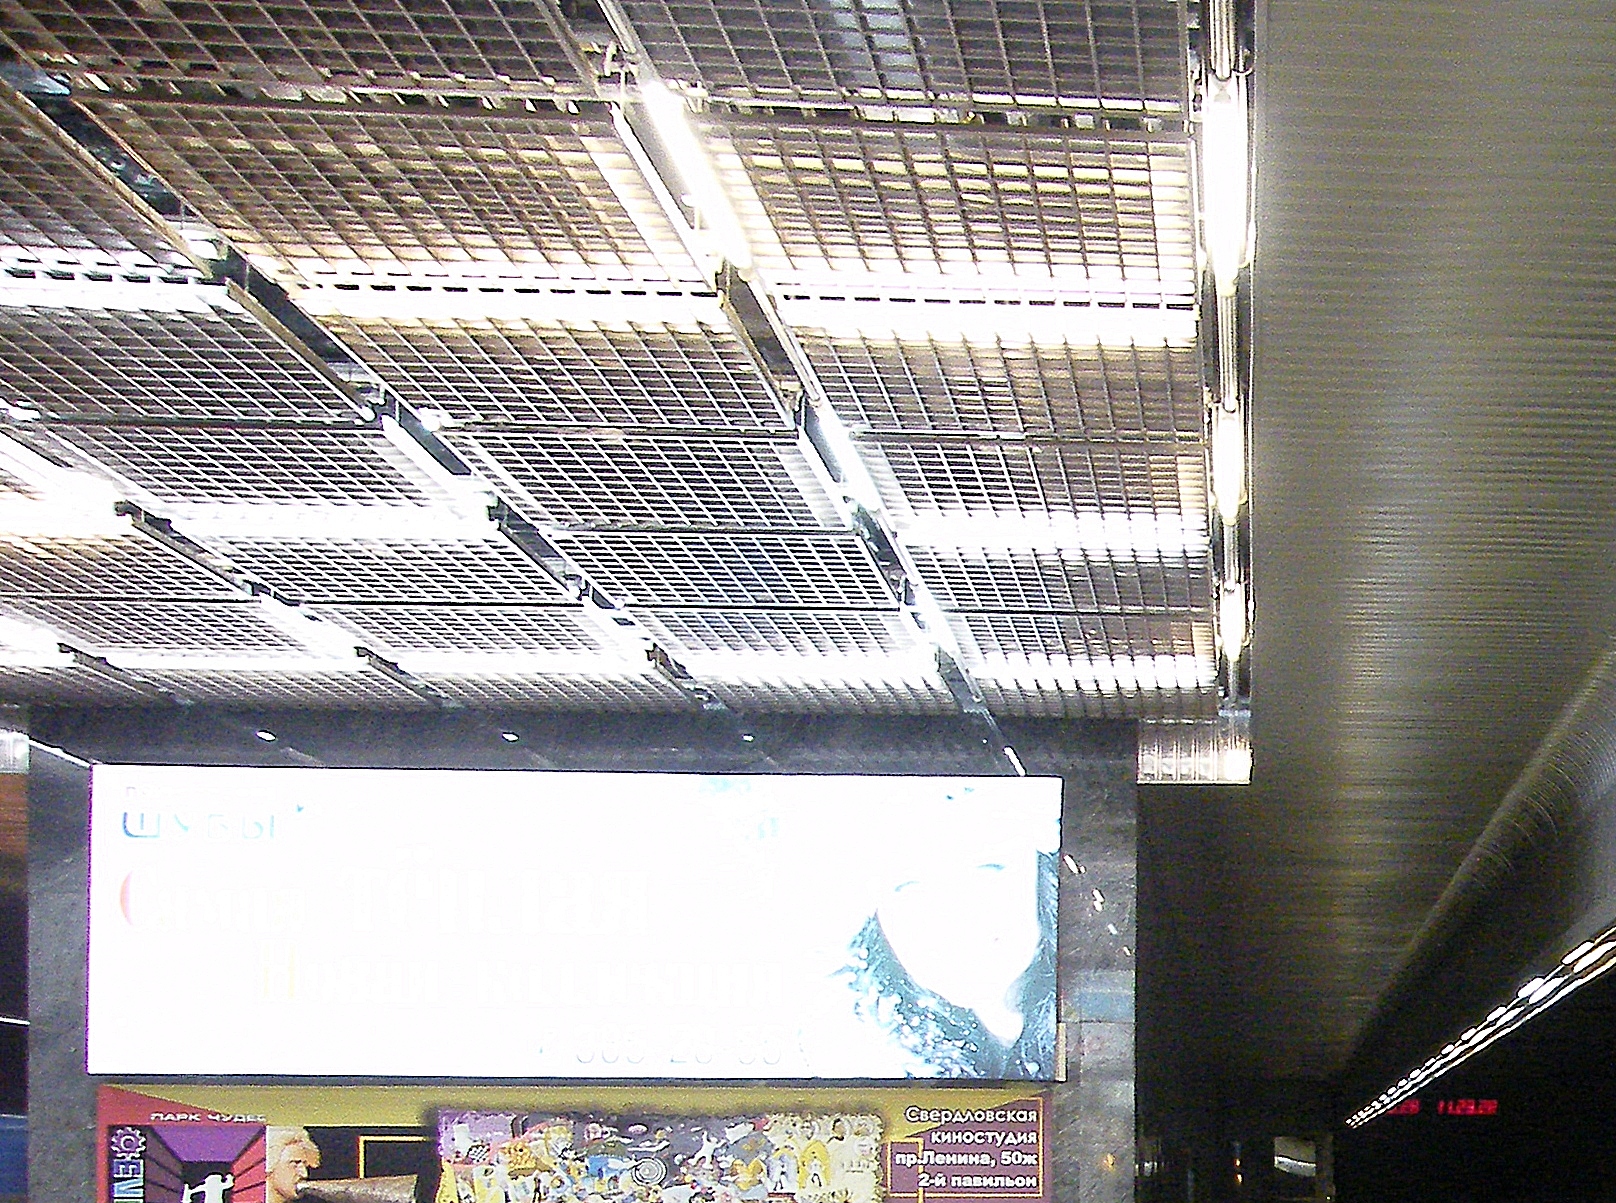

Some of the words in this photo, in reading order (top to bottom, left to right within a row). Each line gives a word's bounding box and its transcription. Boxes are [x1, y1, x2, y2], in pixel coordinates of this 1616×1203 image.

[150, 1112, 202, 1123] ПАРК
[206, 1112, 267, 1124] ЧУДЕС
[905, 1105, 1037, 1125] Свердловская
[930, 1131, 1037, 1147] киностудия
[895, 1150, 997, 1168] пр.Ленина,
[1000, 1150, 1038, 1166] 50ж
[917, 1172, 947, 1188] 2-й
[950, 1174, 1037, 1188] павильон
